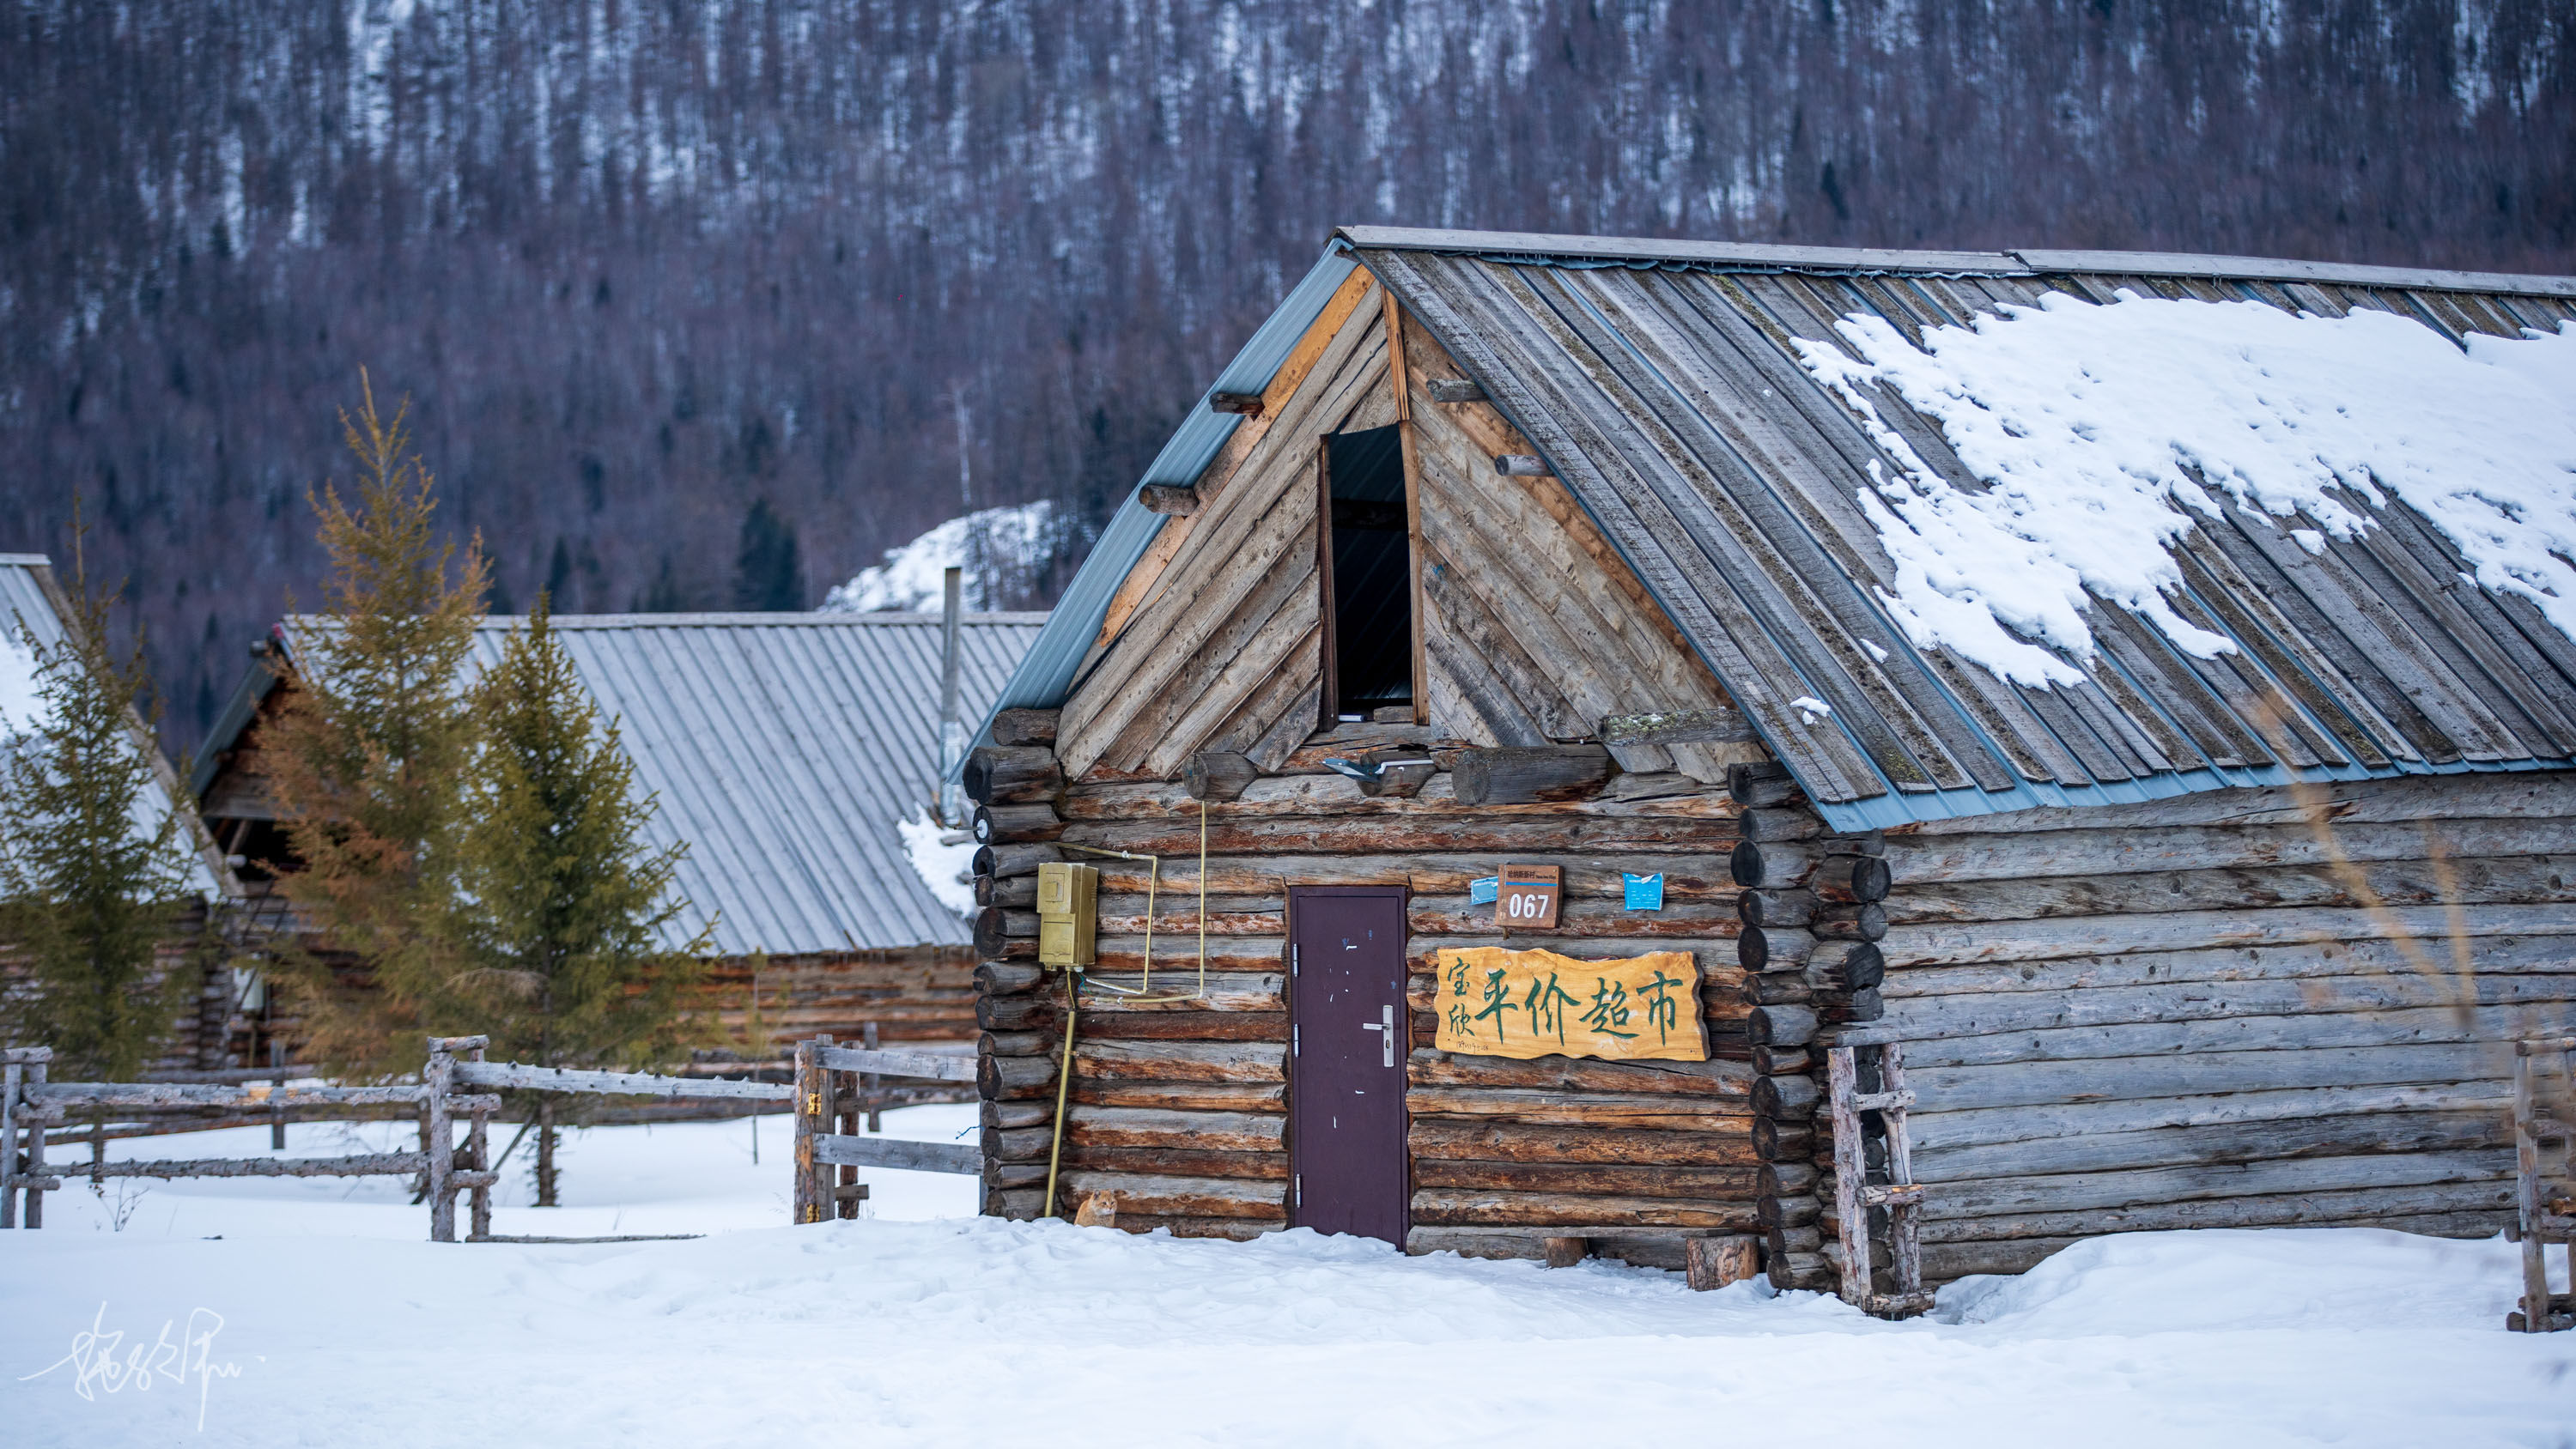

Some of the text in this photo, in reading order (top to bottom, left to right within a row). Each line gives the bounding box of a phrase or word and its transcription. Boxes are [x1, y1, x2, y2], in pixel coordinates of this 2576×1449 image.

[1510, 893, 1549, 919] 067
[1474, 968, 1683, 1046] 平价超市
